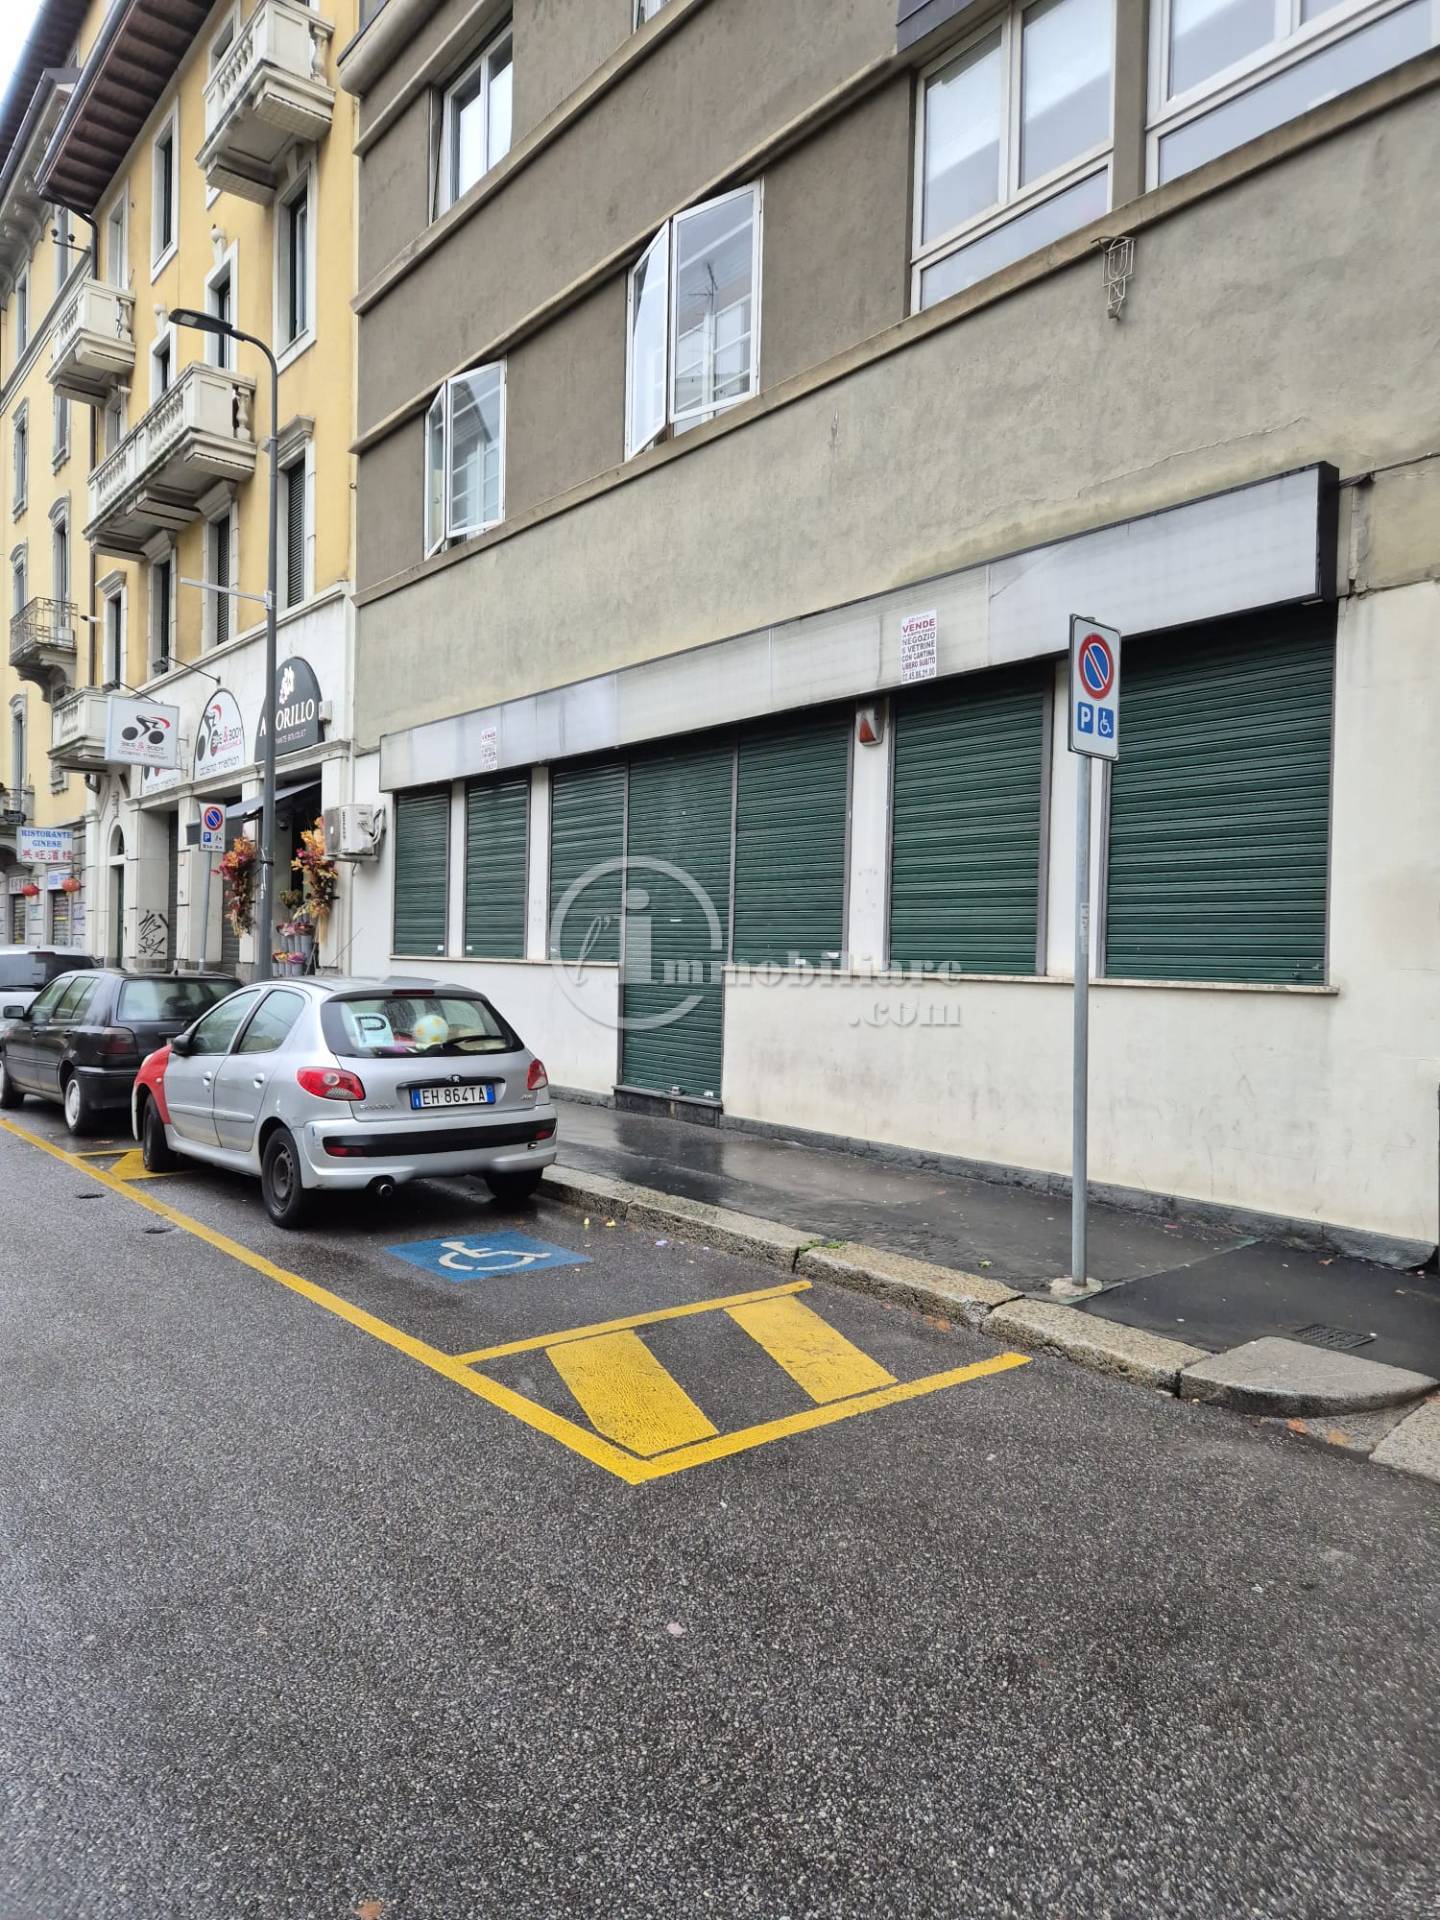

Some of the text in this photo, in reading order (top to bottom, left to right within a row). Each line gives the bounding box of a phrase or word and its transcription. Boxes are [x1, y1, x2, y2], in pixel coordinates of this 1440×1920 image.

[902, 618, 935, 633] VENDE
[903, 632, 935, 645] NEGOZIO
[908, 640, 935, 653] VETRINE
[259, 699, 315, 736] AORILLO
[1081, 706, 1091, 729] P
[22, 830, 72, 839] RISTORANTE
[422, 1089, 439, 1105] EH
[444, 1086, 486, 1103] 864TA
